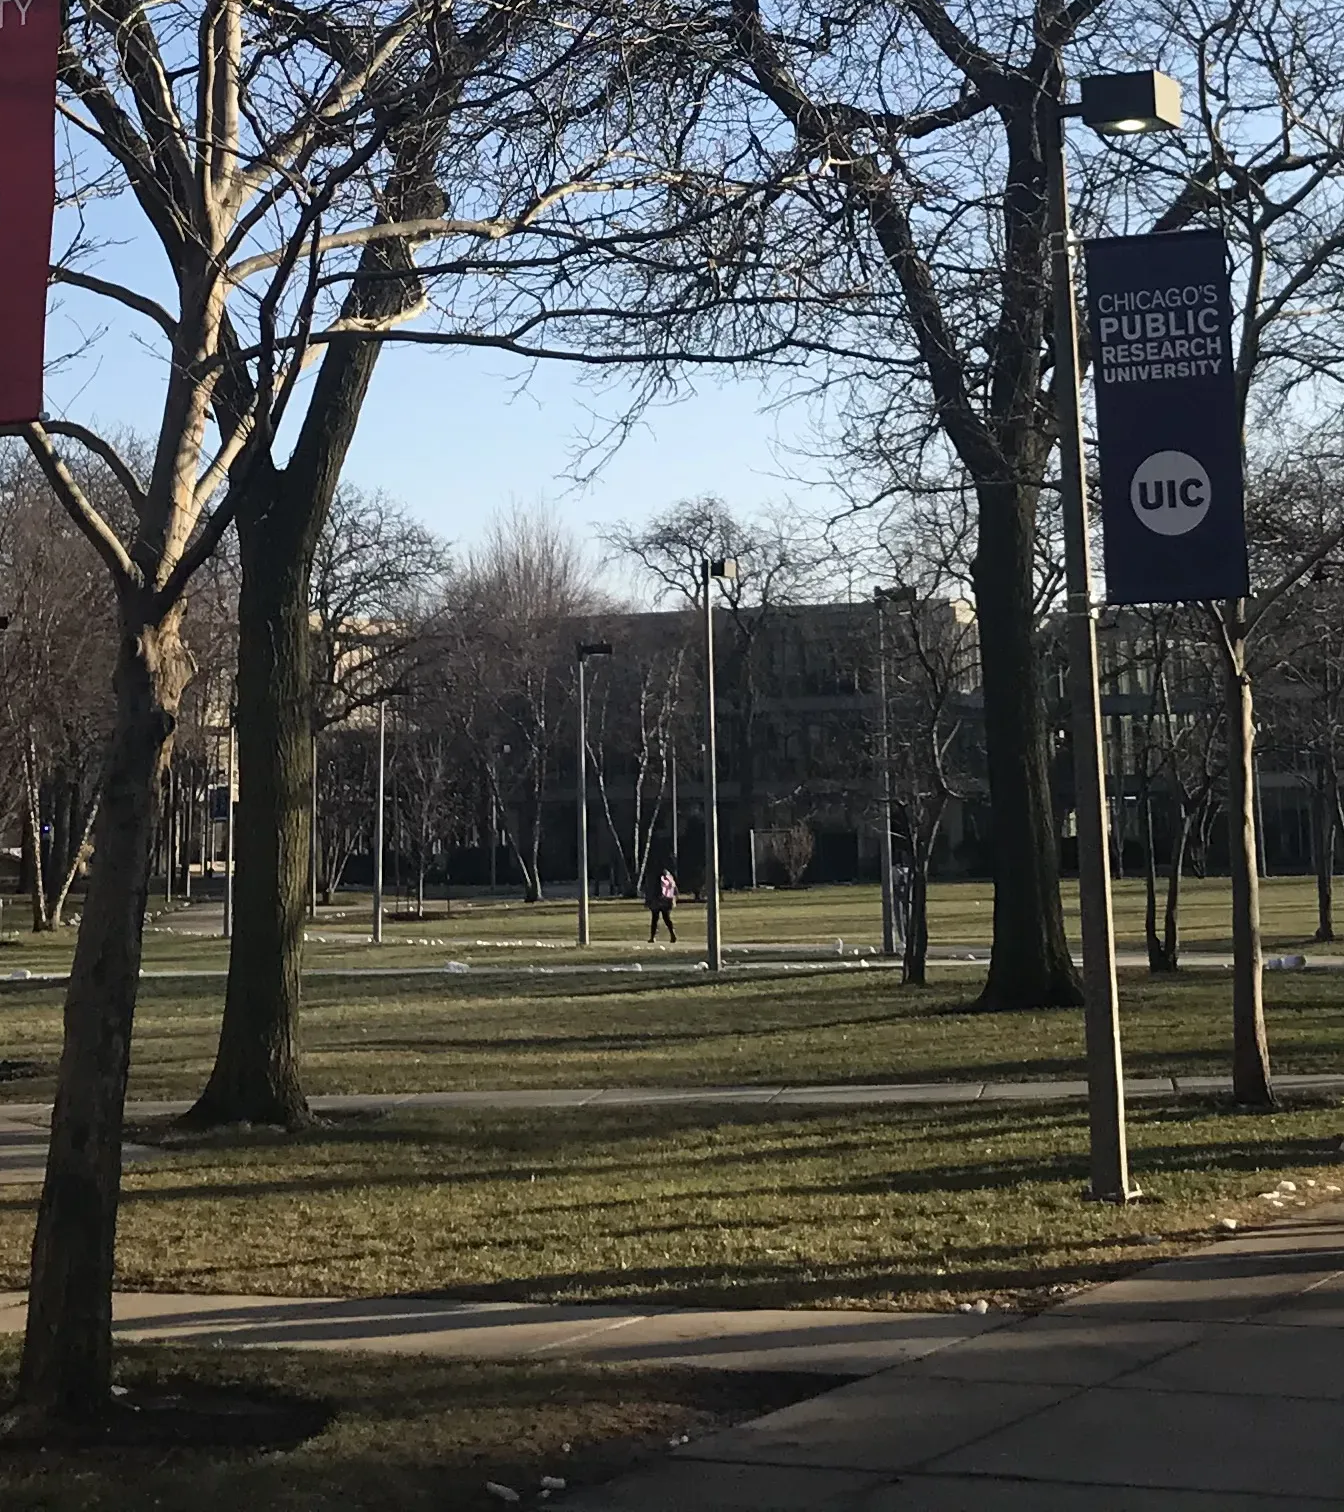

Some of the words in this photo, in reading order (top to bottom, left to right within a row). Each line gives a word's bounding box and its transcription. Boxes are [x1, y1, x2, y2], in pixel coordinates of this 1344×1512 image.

[1099, 307, 1220, 343] PUBLIC
[1101, 336, 1223, 365] RESEARCH
[1102, 358, 1223, 384] UNIVERSITY
[1137, 477, 1205, 511] UIC
